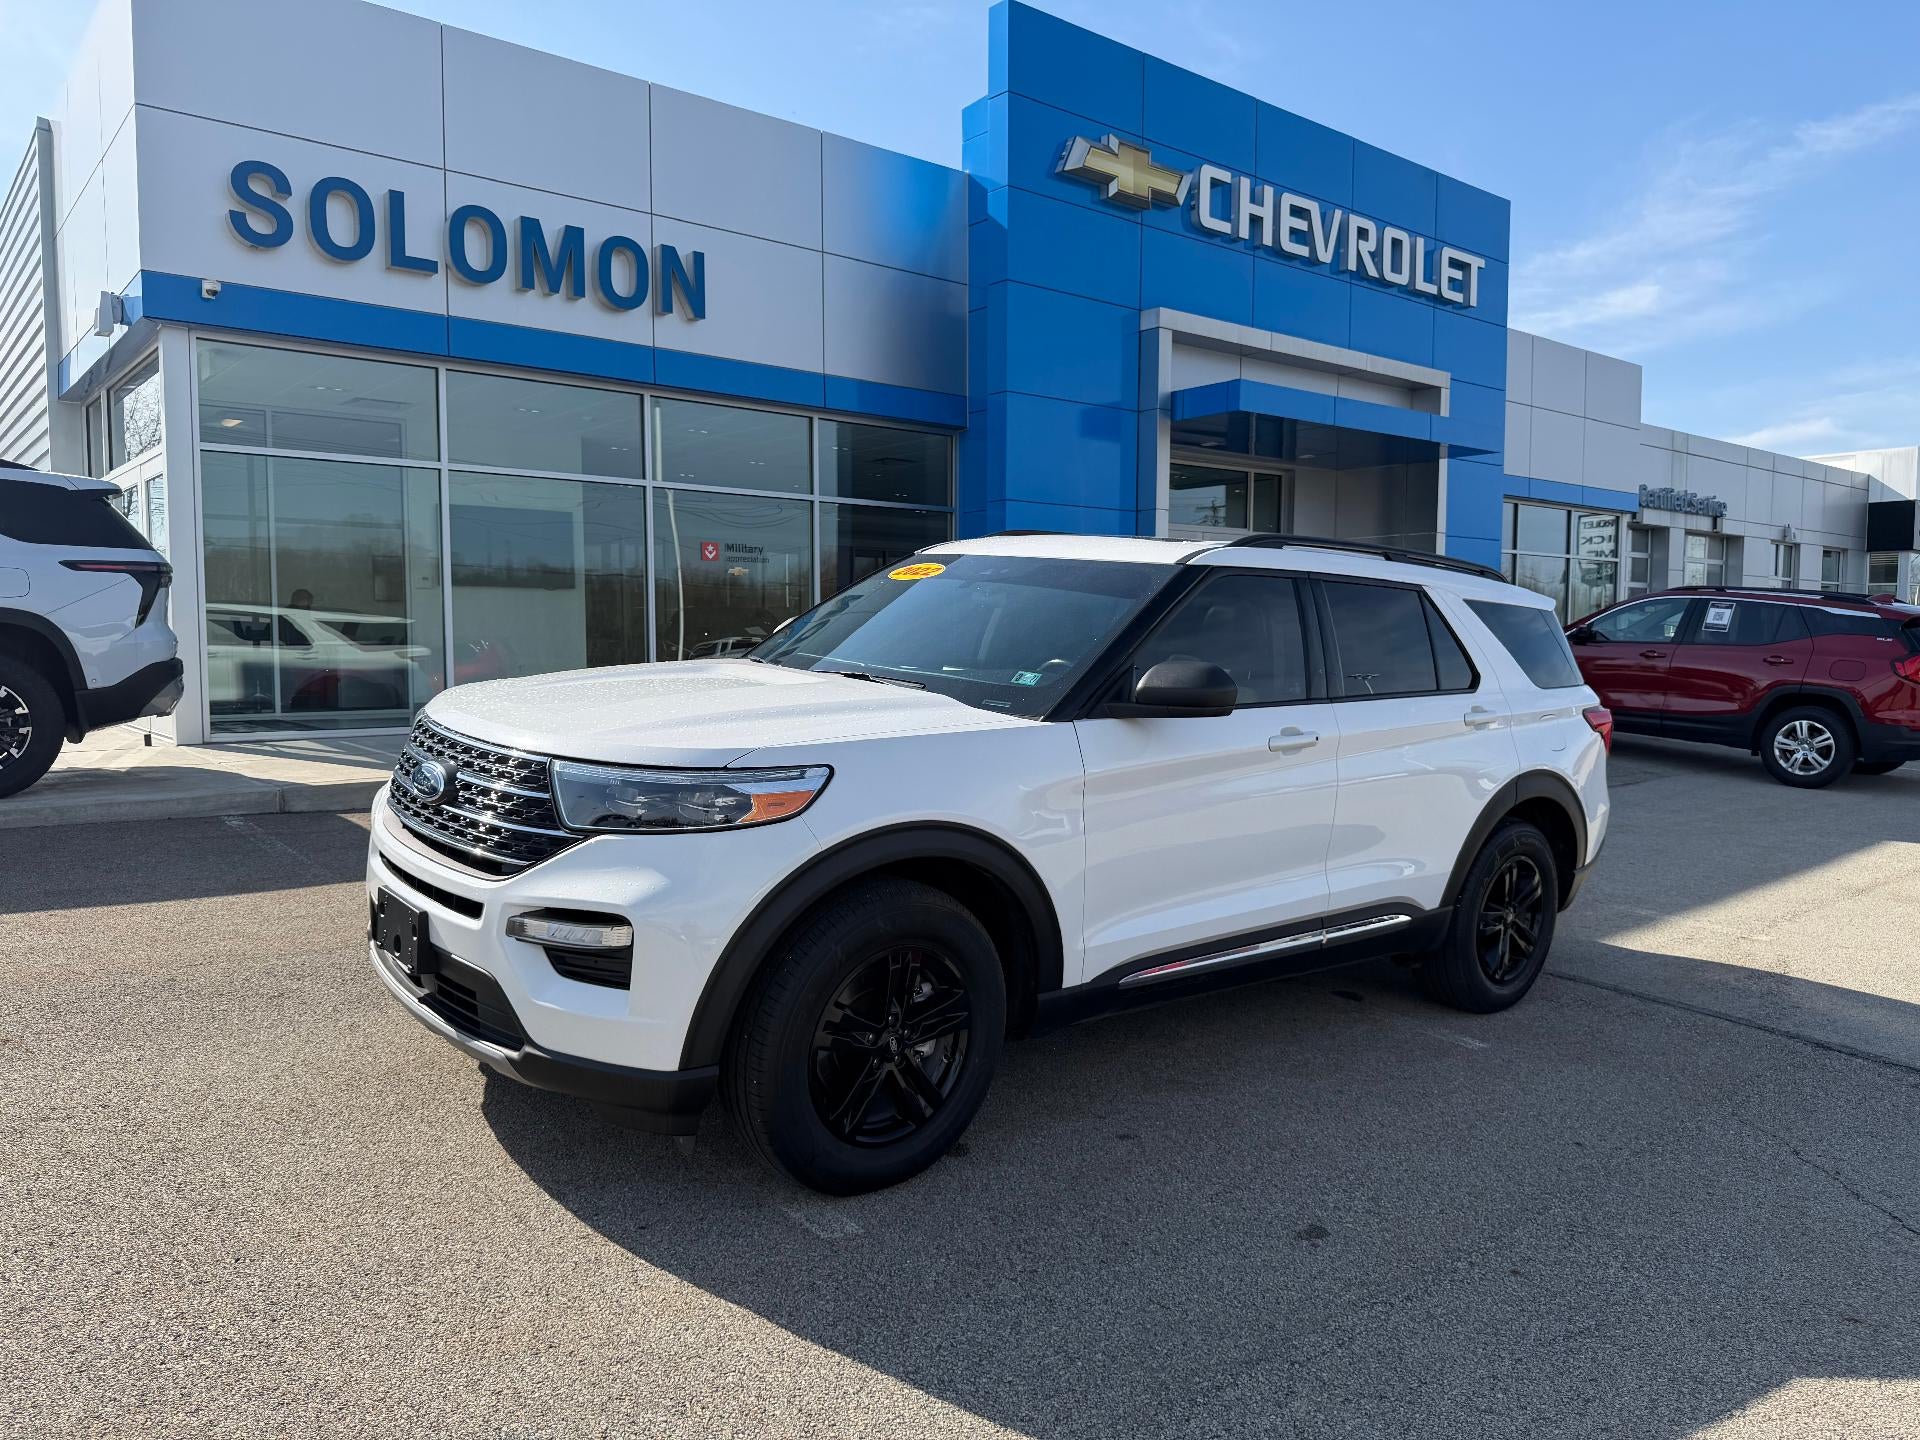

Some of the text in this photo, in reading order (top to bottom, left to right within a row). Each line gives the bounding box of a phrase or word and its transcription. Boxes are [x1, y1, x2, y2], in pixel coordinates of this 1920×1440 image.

[227, 159, 707, 322] SOLOMON
[1192, 163, 1486, 308] CHEVROLET
[724, 543, 764, 555] Military
